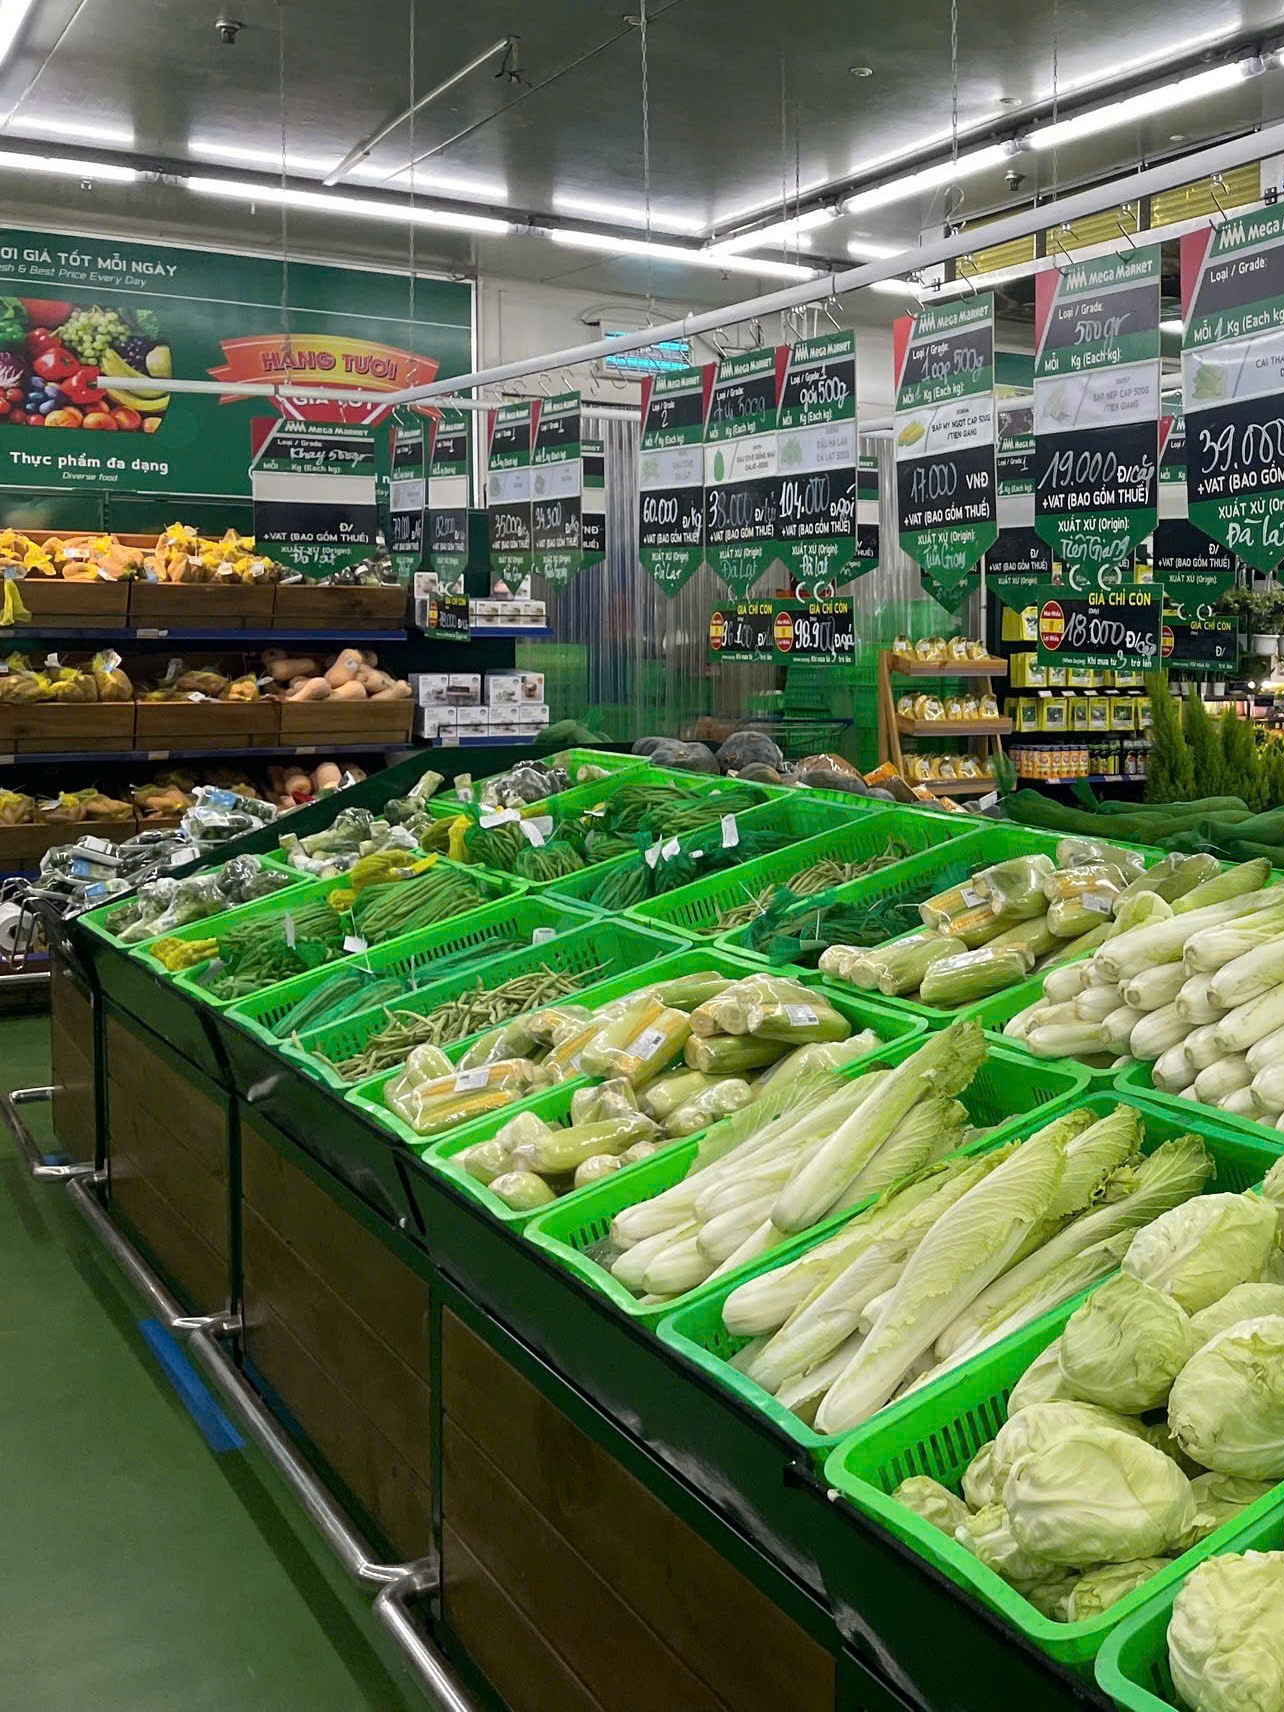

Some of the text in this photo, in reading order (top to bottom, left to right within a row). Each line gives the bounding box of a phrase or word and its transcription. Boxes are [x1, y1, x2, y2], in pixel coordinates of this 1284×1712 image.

[23, 248, 51, 263] GIÁ
[57, 250, 92, 267] TỐT
[98, 253, 126, 271] MỖI
[132, 260, 177, 277] NGÀY
[30, 267, 55, 276] Best
[59, 269, 87, 280] Price
[90, 272, 122, 285] Every
[125, 275, 147, 288] Day
[10, 451, 169, 474] Thực phẩm đa dạng
[1037, 450, 1117, 489] 19.000
[62, 472, 118, 482] Diverse food
[911, 463, 988, 503] 17.000 VNĐ
[1198, 477, 1225, 495] +VAT
[1229, 472, 1257, 493] (BAO
[1043, 481, 1149, 509] +VAT (BAO GỒM THUẾ)
[904, 498, 990, 526] +VAT (BAO GỒM THUẾ)
[290, 533, 314, 541] (BAO
[918, 530, 936, 545] XUẤT
[1088, 588, 1151, 606] GIÁ CHỈ CÒN
[1062, 612, 1125, 647] 18.000
